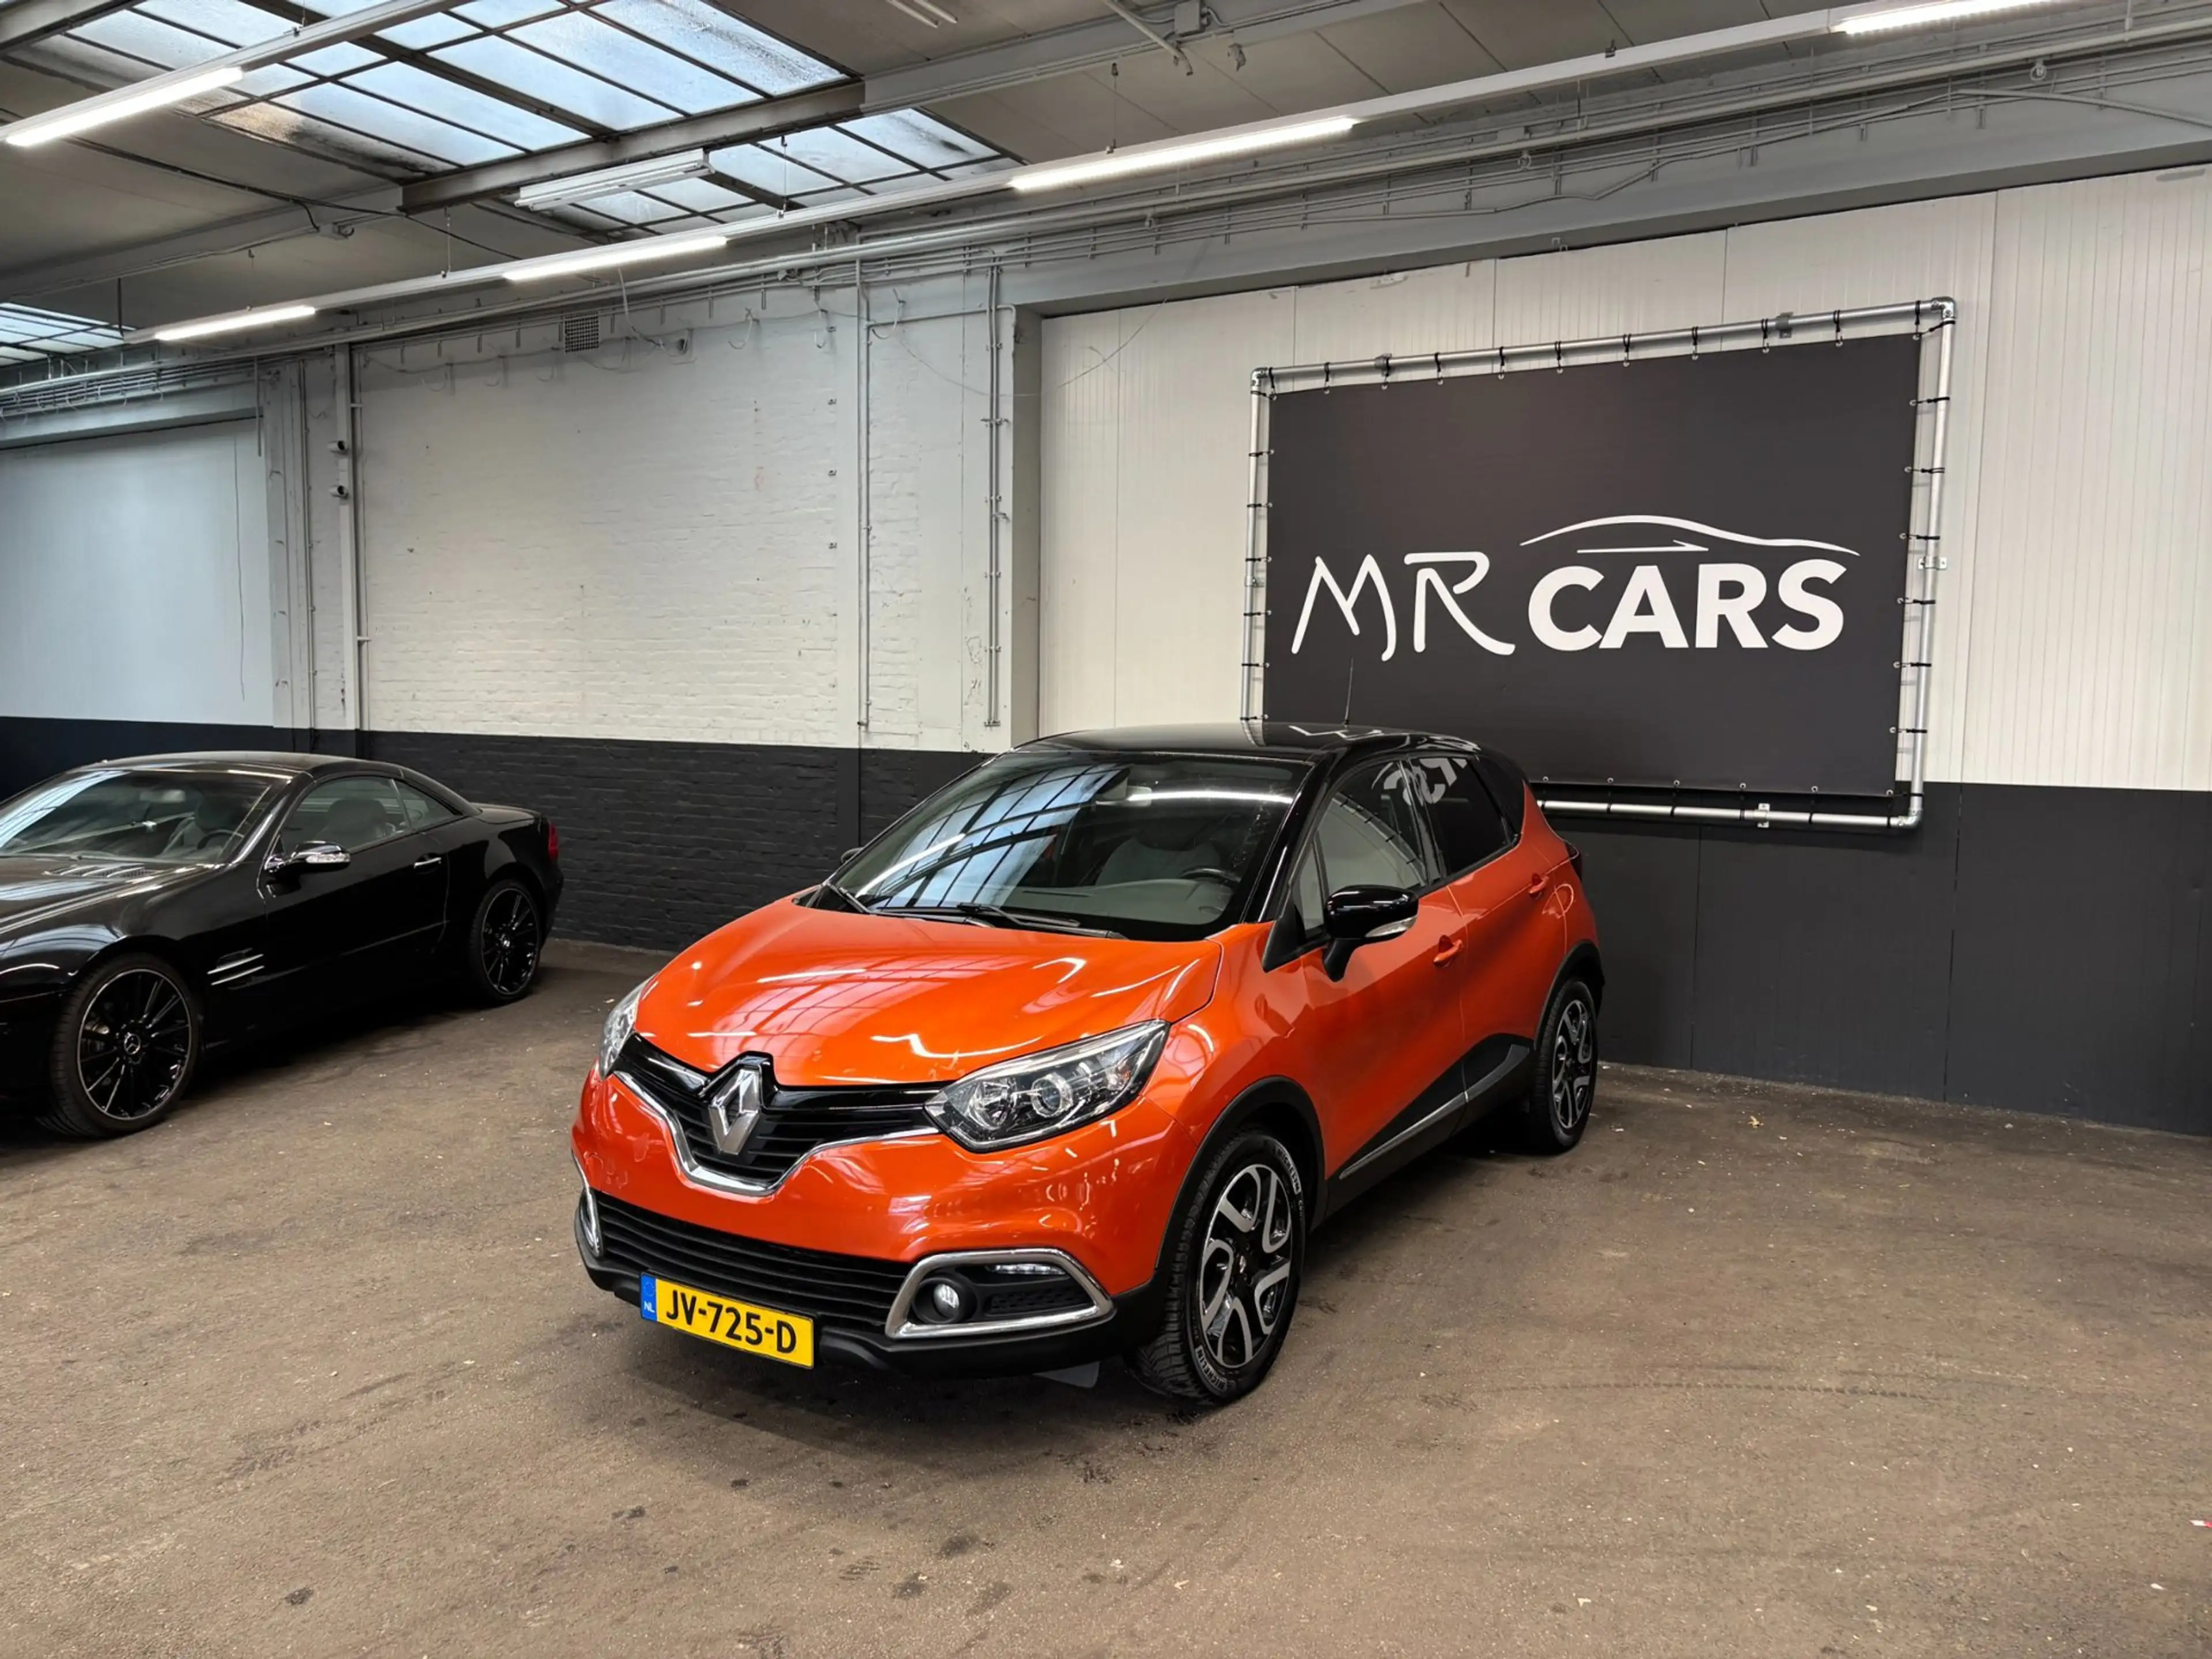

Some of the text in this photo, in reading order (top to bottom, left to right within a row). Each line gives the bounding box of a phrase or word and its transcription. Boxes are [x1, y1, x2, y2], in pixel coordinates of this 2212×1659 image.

[1291, 551, 1847, 661] MR CARS
[644, 1301, 655, 1313] NL
[666, 1290, 797, 1354] JV-725-D
